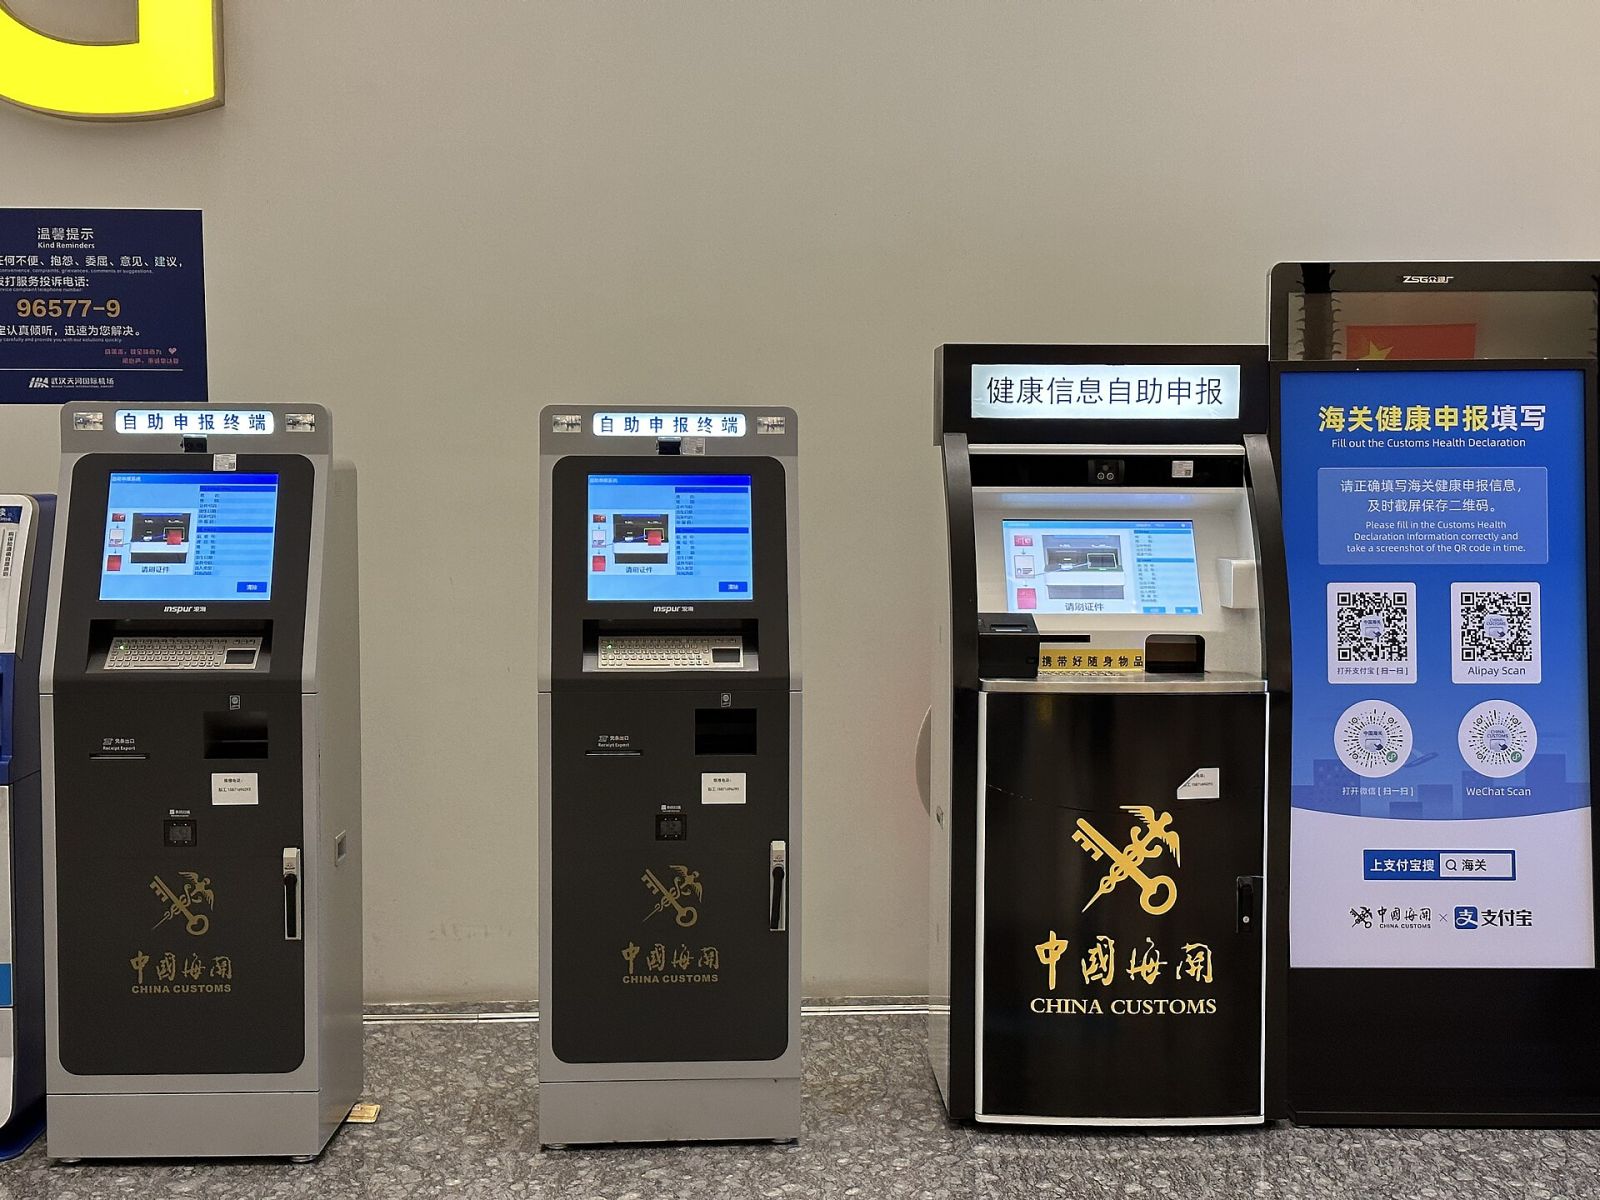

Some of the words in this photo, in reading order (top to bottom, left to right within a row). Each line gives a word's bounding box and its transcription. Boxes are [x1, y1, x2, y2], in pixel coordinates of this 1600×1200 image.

[37, 227, 94, 241] 温馨提示
[16, 298, 121, 318] 96577-9
[987, 375, 1223, 406] 健康信息自助申报
[123, 412, 266, 431] 自助申报终端
[600, 416, 738, 434] 自助申报终端
[1318, 404, 1546, 433] 海关健康申报填写
[1331, 438, 1347, 448] Fill
[1349, 440, 1366, 448] out
[1367, 438, 1385, 448] the
[1387, 438, 1430, 448] Customs
[1432, 438, 1466, 447] Health
[1468, 438, 1526, 447] Declaration
[1367, 499, 1496, 513] 及时截屏保存二维码。
[1366, 521, 1395, 529] Please
[1397, 521, 1408, 529] fill
[1410, 521, 1419, 529] in
[1420, 521, 1435, 529] the
[1437, 521, 1475, 529] Customs
[1477, 521, 1506, 529] Health
[1354, 532, 1404, 540] Declaration
[1461, 532, 1499, 542] correctly
[1501, 532, 1519, 540] and
[1347, 544, 1366, 552] take
[1376, 544, 1424, 552] screenshot
[1426, 544, 1435, 552] of
[1437, 544, 1452, 552] the
[1454, 544, 1467, 552] QR
[1469, 544, 1490, 552] code
[1493, 544, 1501, 552] in
[1503, 543, 1526, 552] time.
[1468, 666, 1499, 676] Alipay
[1502, 666, 1526, 675] Scan
[1466, 787, 1504, 796] WeChat
[1507, 787, 1531, 796] Scan
[1370, 859, 1435, 872] 上支付宝搜
[1462, 859, 1487, 871] 海关
[1481, 909, 1532, 927] 支付宝
[622, 974, 660, 984] CHINA
[662, 974, 719, 984] CUSTOMS
[131, 984, 170, 994] CHINA
[173, 983, 232, 993] CUSTOMS
[1030, 998, 1103, 1014] CHINA
[1110, 998, 1217, 1015] CUSTOMS
